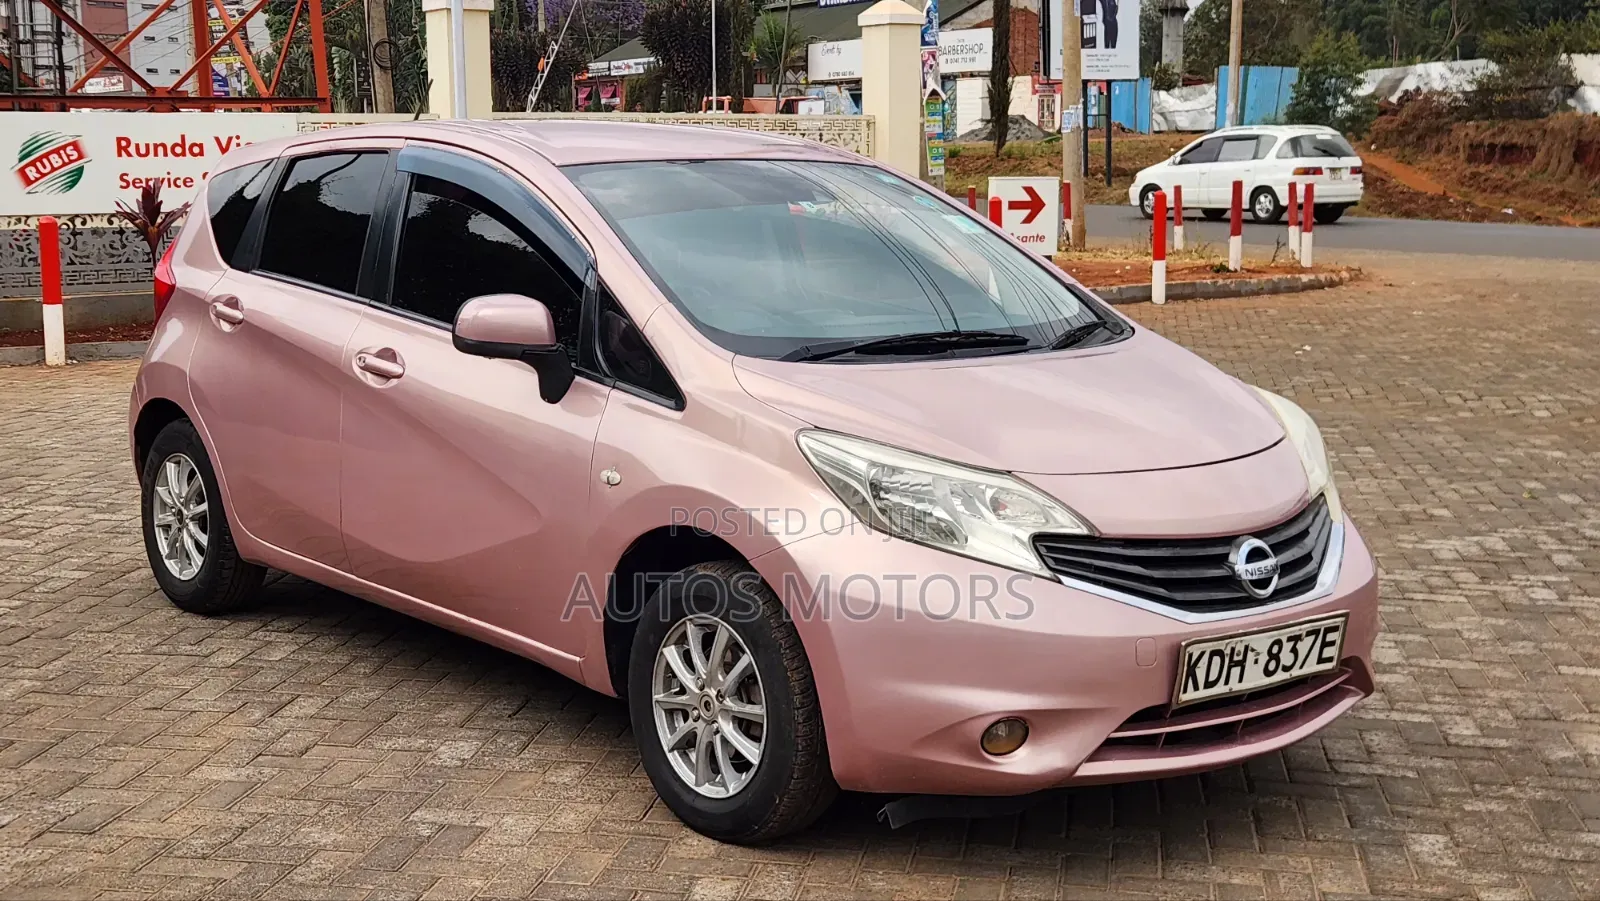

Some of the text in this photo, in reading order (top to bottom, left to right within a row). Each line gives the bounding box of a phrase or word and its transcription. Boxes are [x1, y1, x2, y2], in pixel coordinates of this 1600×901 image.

[116, 134, 253, 157] Runda Vi
[24, 145, 79, 181] RUBIS
[1010, 233, 1046, 243] sante
[1182, 625, 1341, 695] KDH 837E
